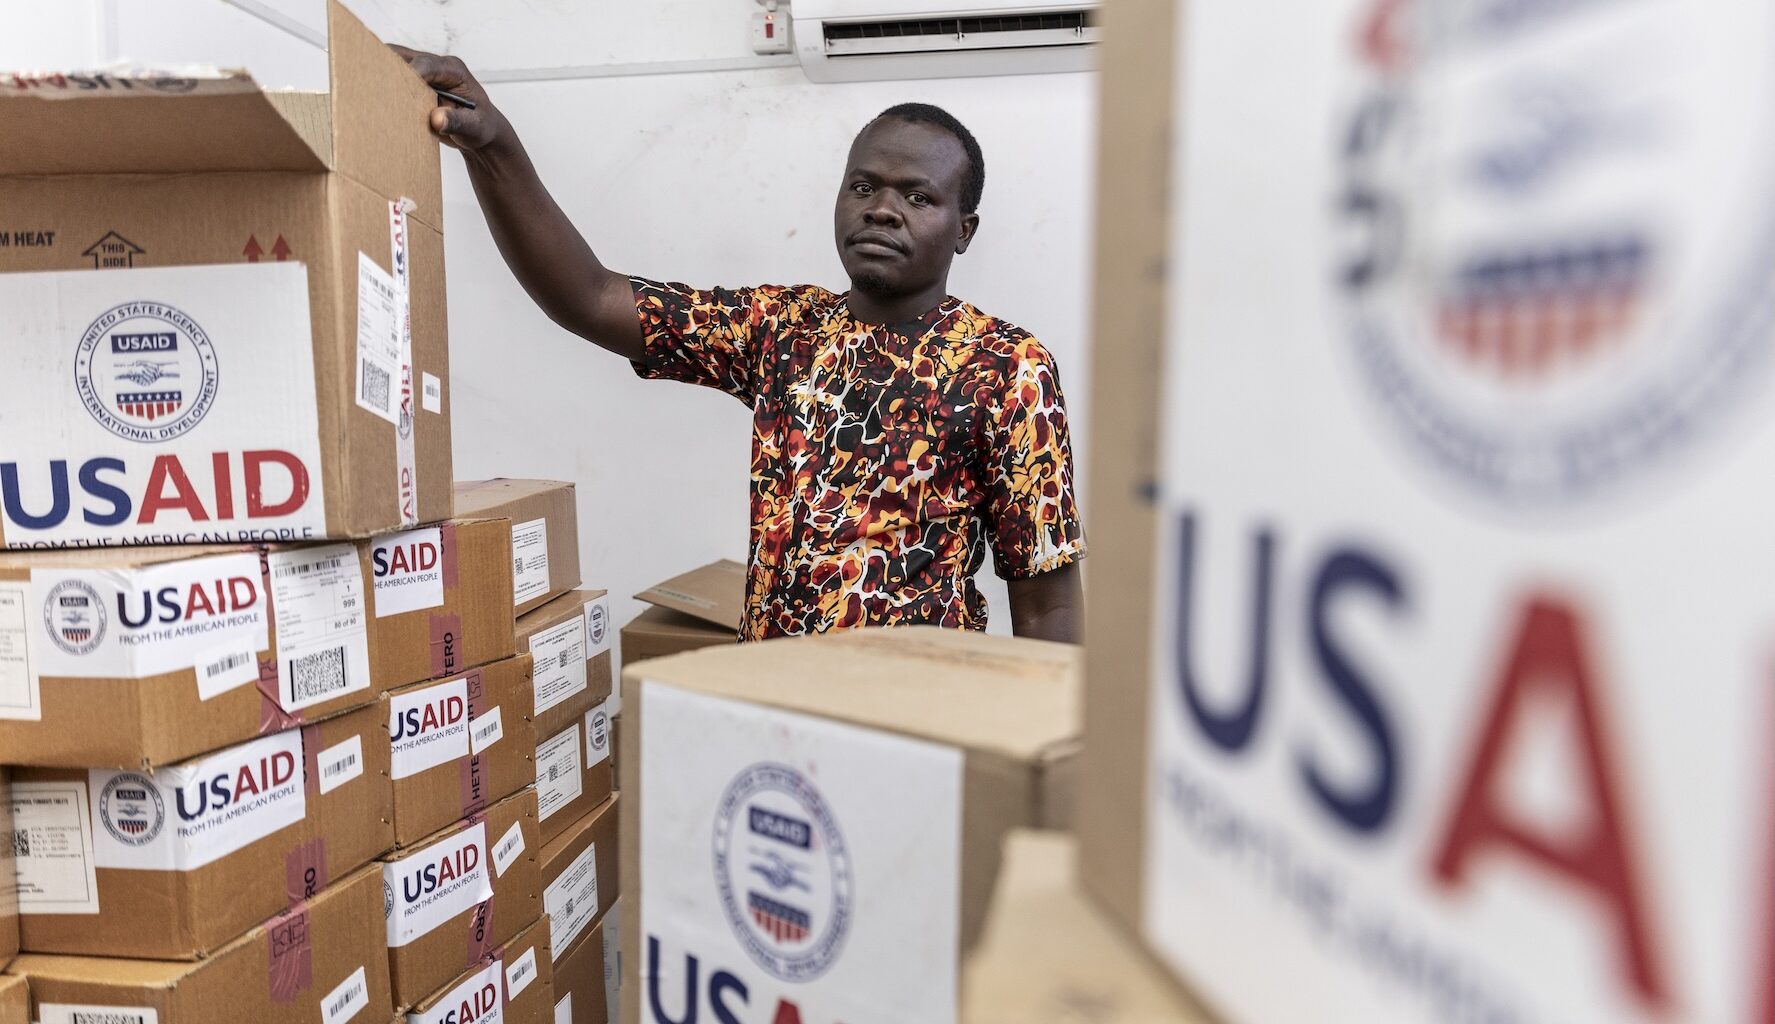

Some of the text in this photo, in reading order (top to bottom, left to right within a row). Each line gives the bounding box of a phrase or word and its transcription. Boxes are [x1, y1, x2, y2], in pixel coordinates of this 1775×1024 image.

[14, 231, 55, 247] HEAT
[101, 243, 126, 253] THIS
[103, 257, 127, 267] SIDE
[82, 304, 208, 352] UNITED STATES AGENCY
[116, 335, 171, 350] USAID
[79, 369, 215, 441] INTERNATIONAL DEVELOPMENT
[0, 449, 311, 530] USAID
[373, 542, 438, 578] SAID
[375, 572, 438, 589] HE AMERICAN PEOPLE
[116, 576, 258, 630] USAID
[342, 619, 349, 628] of
[343, 598, 356, 608] 999
[119, 612, 260, 646] FROM THE AMERICAN PEOPLE
[443, 632, 454, 677] TERO
[391, 695, 464, 743] USAID
[391, 724, 464, 754] OM THE AMERICAN PEOPLE
[175, 750, 295, 823] USAID
[471, 755, 480, 800] HETE
[1168, 505, 1775, 1024] USA
[177, 784, 296, 838] FROM THE AMERICAN PEOPLE
[403, 843, 479, 903] USAID
[404, 870, 480, 918] FROM THE AMERICAN PEOPLE
